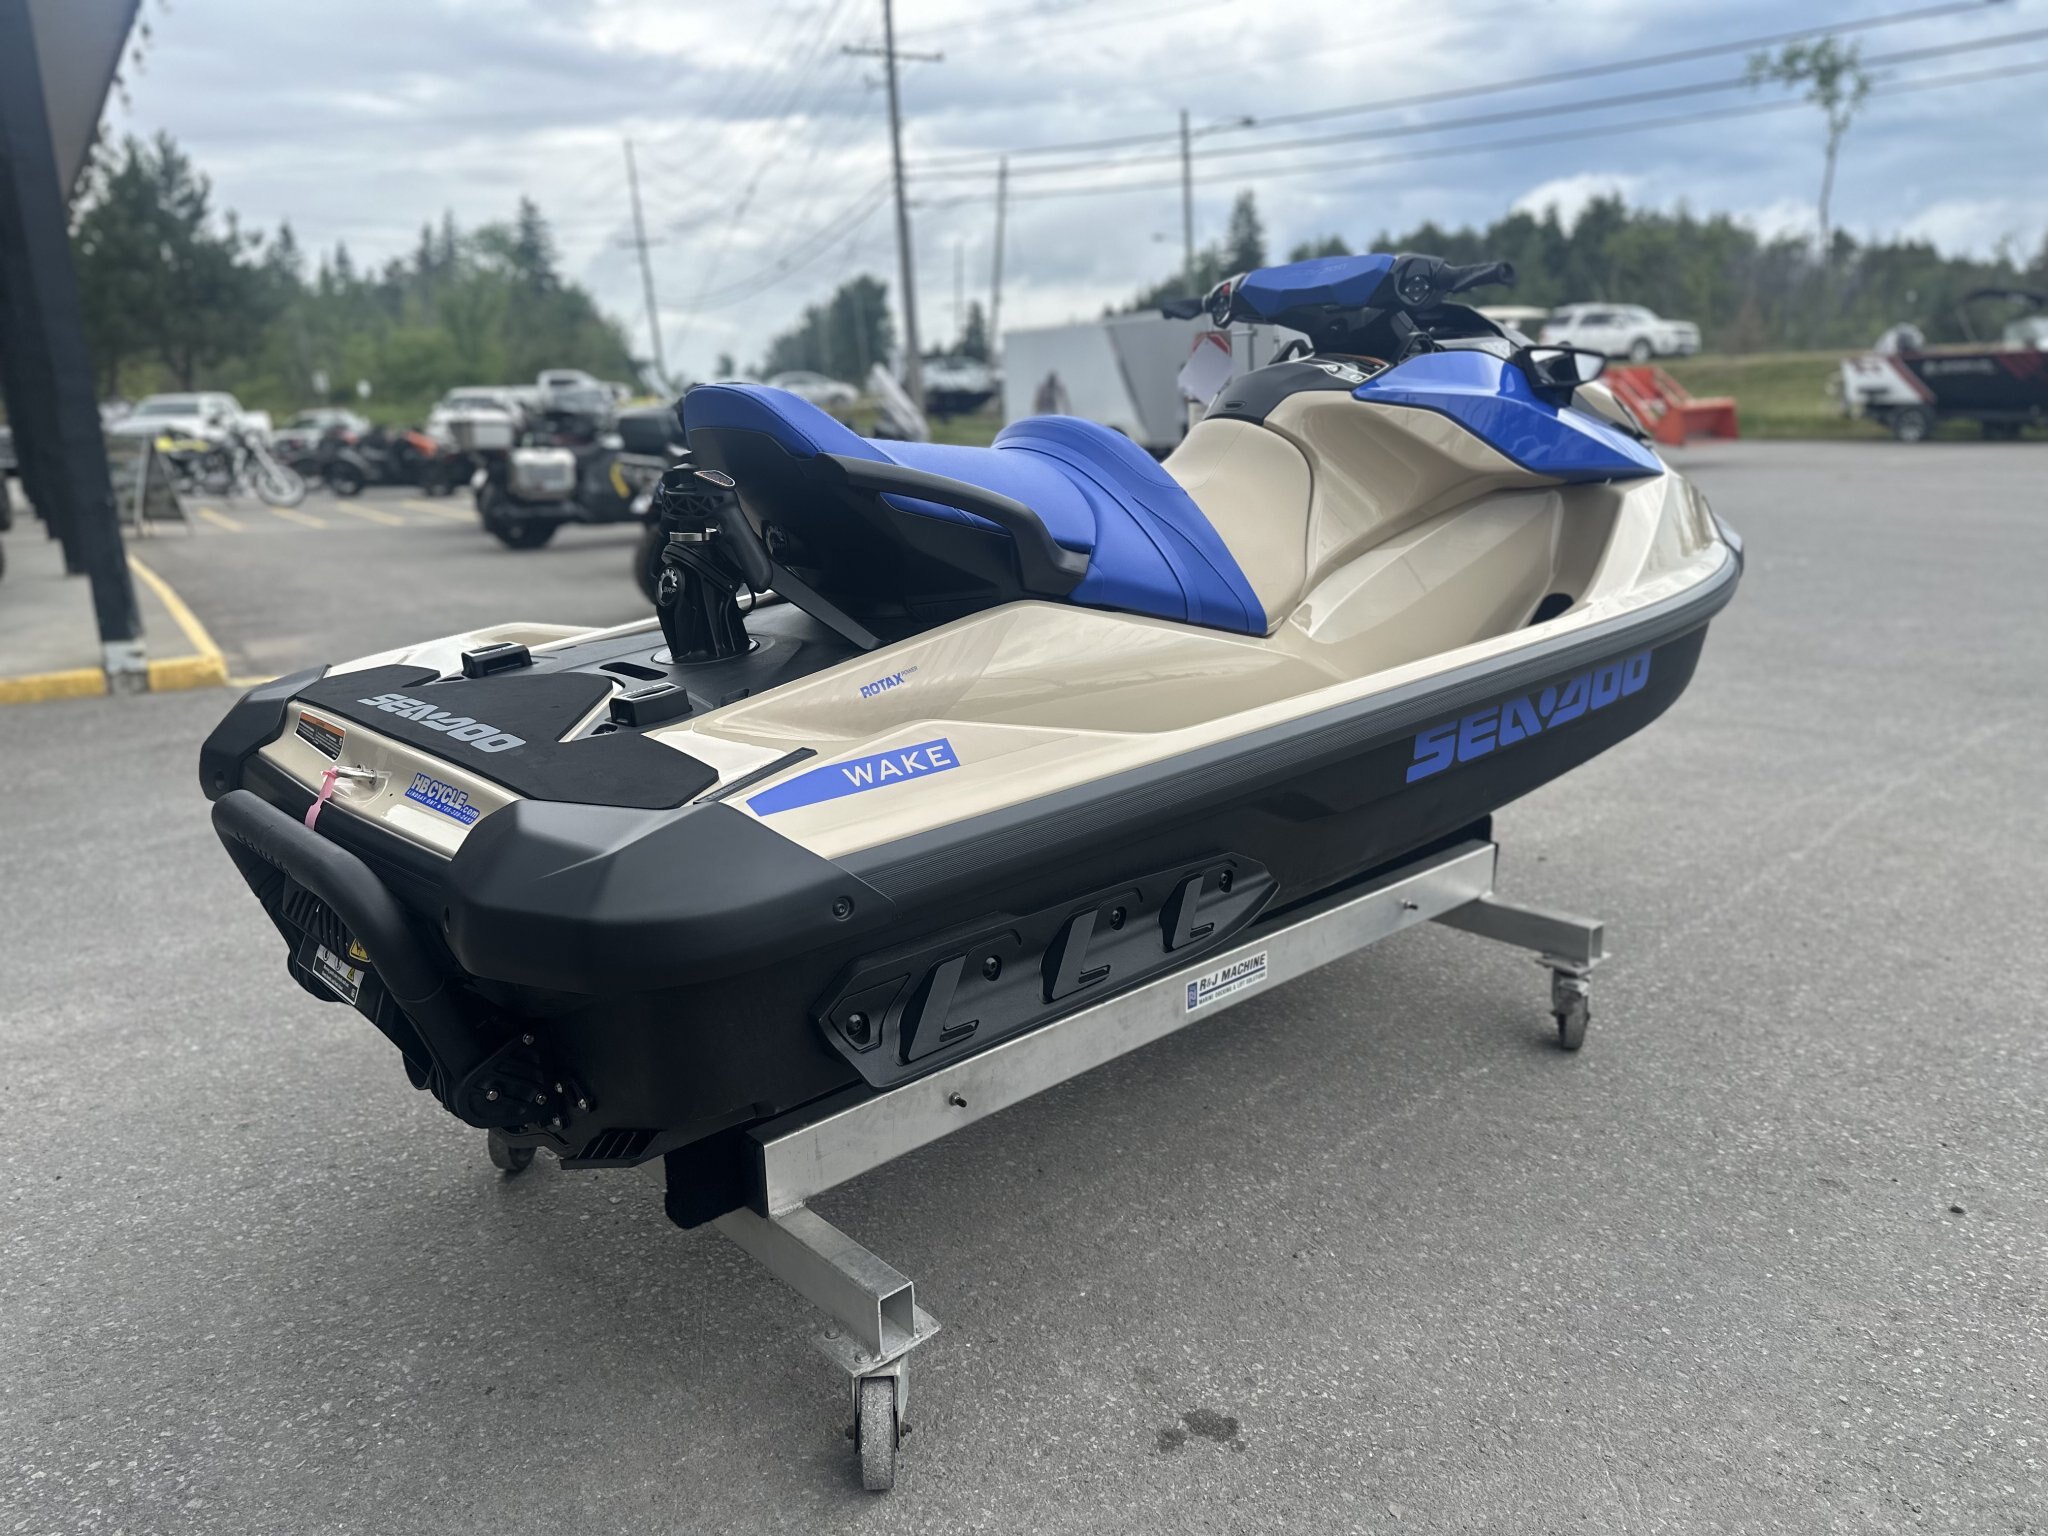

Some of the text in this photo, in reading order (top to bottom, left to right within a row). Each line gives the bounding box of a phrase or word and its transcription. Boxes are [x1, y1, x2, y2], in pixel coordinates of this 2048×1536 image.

[860, 672, 904, 699] ROTAX
[841, 745, 951, 787] WAKE
[1200, 953, 1266, 992] R&J MACHINE
[1199, 993, 1214, 1004] MARINE
